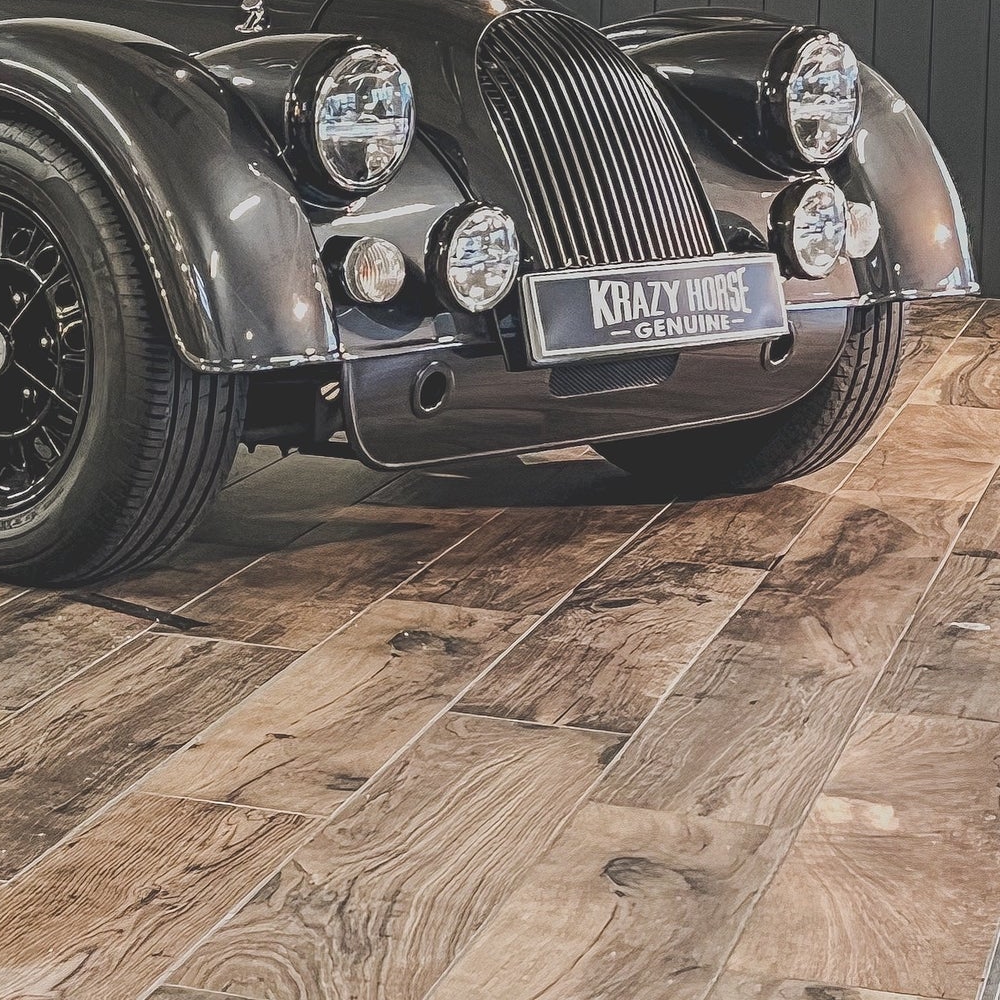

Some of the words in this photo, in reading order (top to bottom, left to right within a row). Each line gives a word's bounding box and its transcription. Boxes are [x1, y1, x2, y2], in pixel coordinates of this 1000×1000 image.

[588, 278, 682, 330] KRAZY
[685, 266, 752, 314] HORSE
[634, 314, 731, 339] GENUINE
